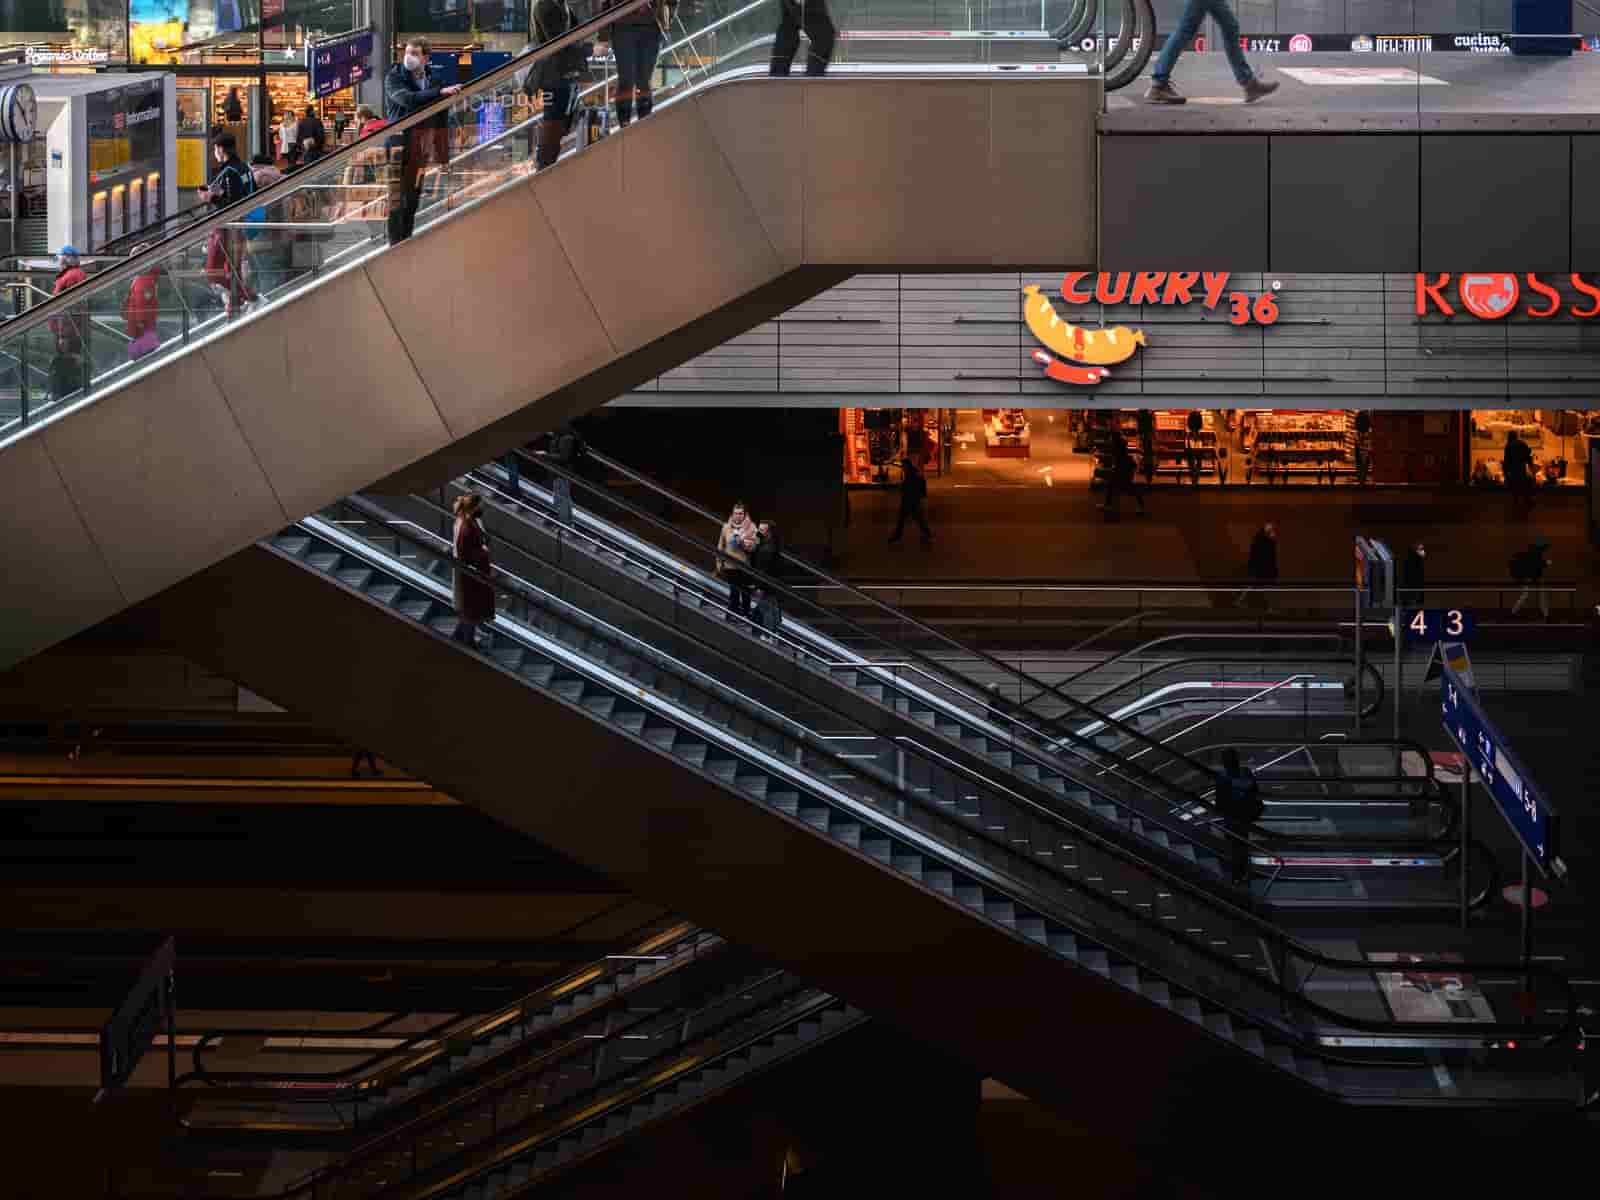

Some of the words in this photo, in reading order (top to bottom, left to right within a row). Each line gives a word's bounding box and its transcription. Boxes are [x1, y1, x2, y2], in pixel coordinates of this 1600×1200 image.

[1061, 272, 1230, 309] CURRY
[1231, 291, 1279, 325] 36
[1410, 610, 1427, 635] 4
[1446, 609, 1464, 635] 3
